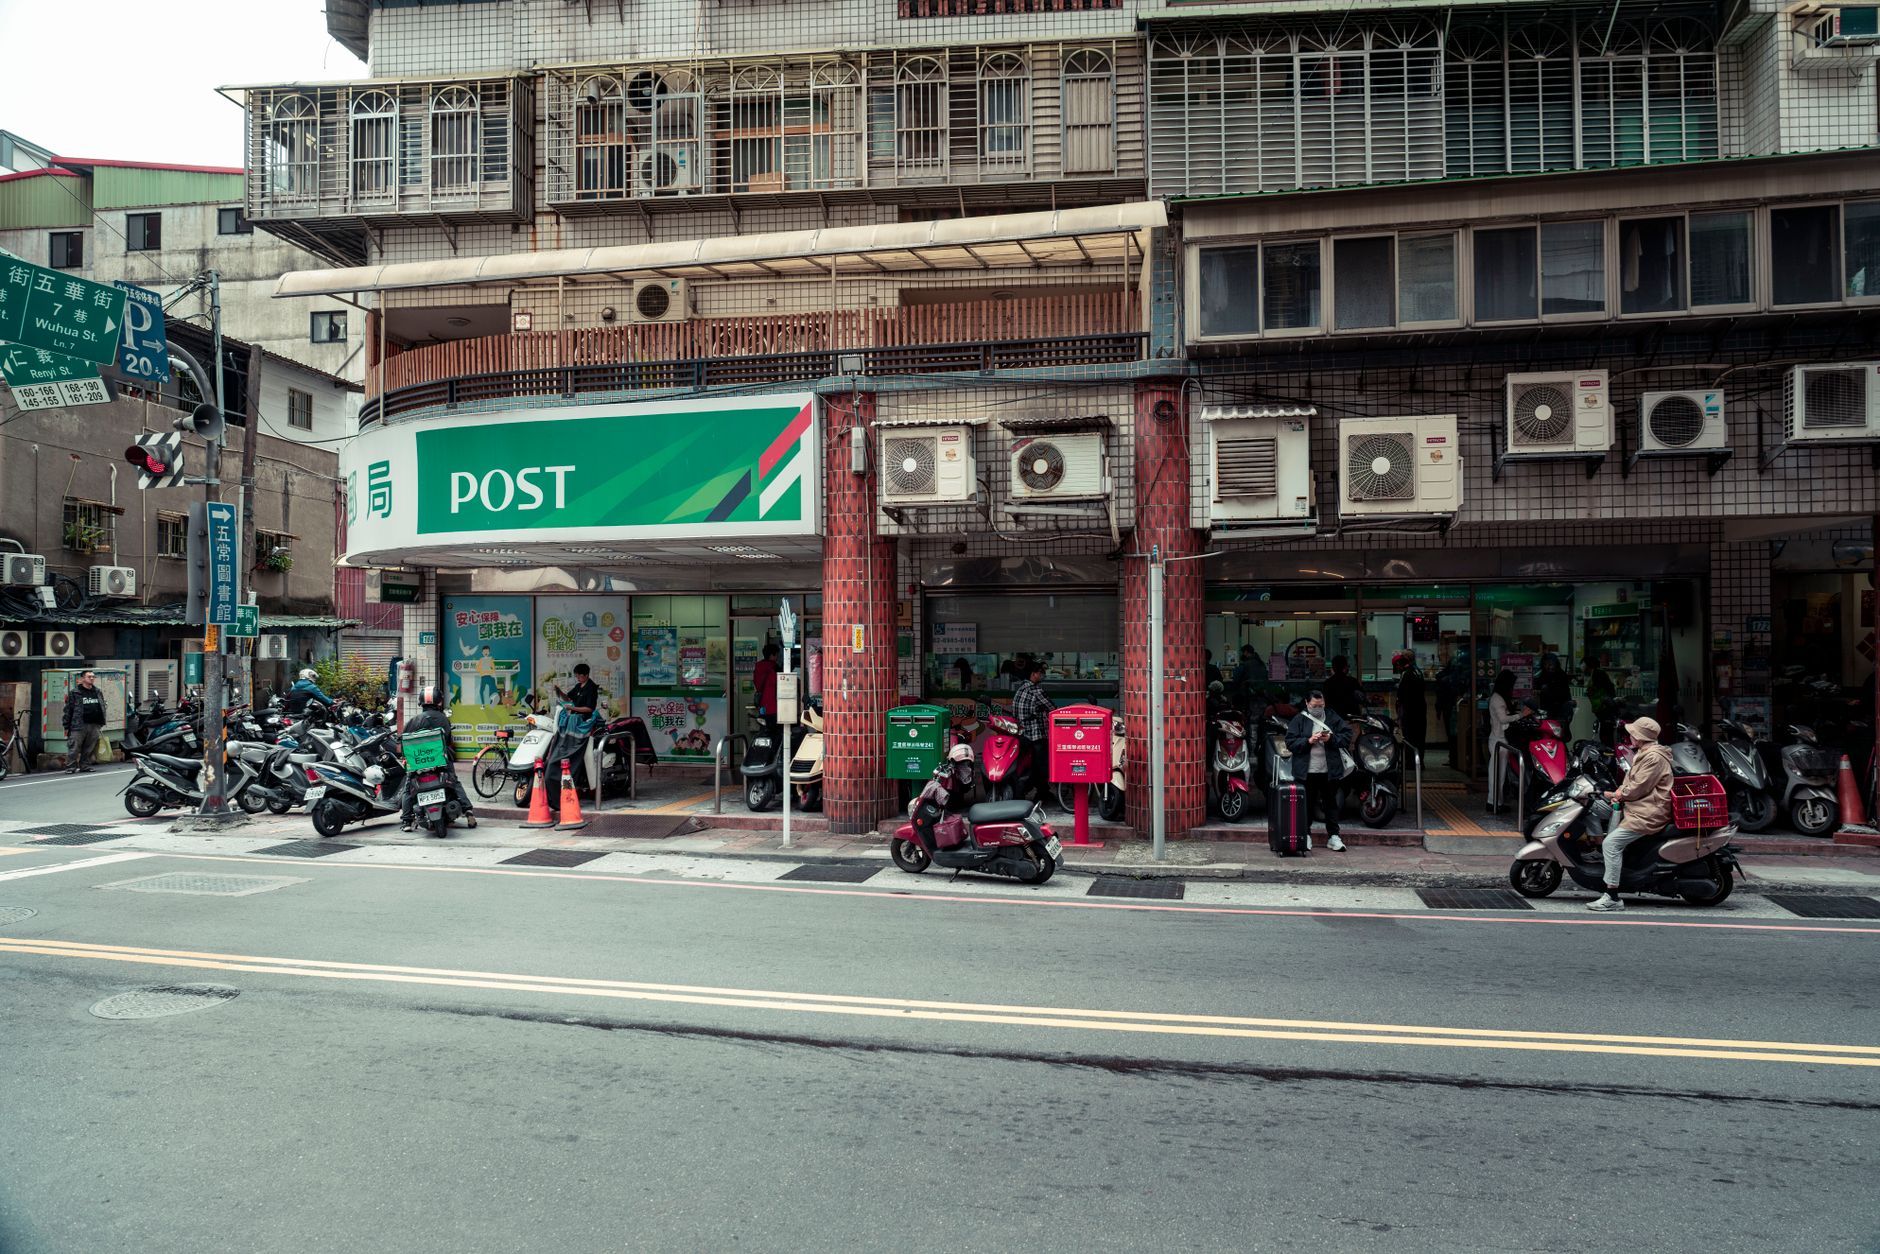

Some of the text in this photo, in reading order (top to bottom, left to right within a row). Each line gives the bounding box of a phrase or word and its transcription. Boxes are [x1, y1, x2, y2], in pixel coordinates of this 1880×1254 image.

[34, 273, 112, 309] 五華街
[53, 303, 88, 324] 7 巷
[35, 317, 98, 342] Wuhua St.
[122, 300, 152, 351] P
[54, 338, 67, 349] Ln.
[125, 353, 152, 376] 20
[30, 366, 73, 379] Renyi St.
[19, 386, 54, 398] 160-166
[64, 381, 99, 393] 168-190
[23, 396, 59, 408] 145-155
[69, 391, 103, 403] 161-209
[451, 465, 576, 513] POST
[216, 525, 231, 621] 五常圖書館
[456, 610, 499, 627] 安心保障
[1752, 621, 1770, 631] 172
[413, 747, 434, 758] Uber
[414, 755, 436, 765] Eats
